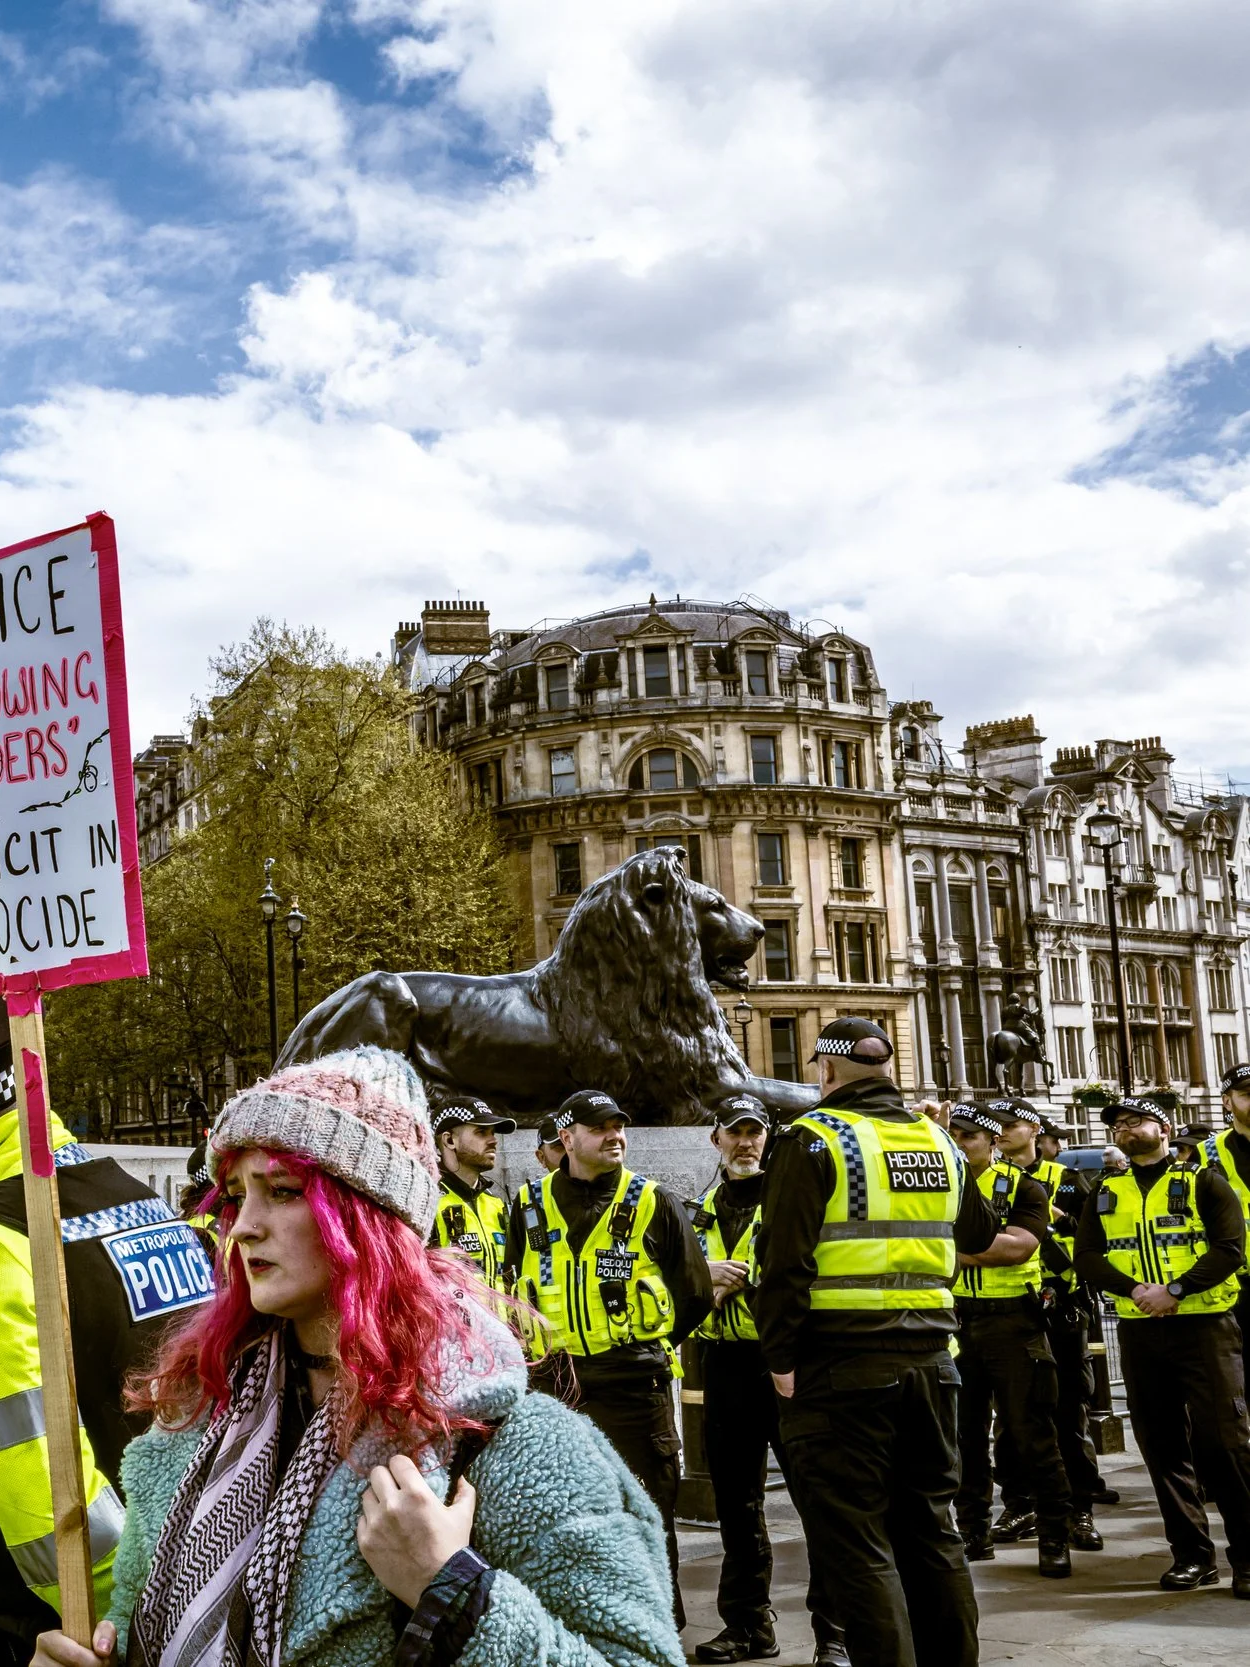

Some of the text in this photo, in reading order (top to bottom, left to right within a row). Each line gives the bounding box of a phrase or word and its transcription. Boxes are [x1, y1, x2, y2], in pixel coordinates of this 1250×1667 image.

[89, 819, 119, 869] IN
[886, 1152, 944, 1168] HEDDLU
[892, 1171, 948, 1187] POLICE
[113, 1229, 196, 1258] METROPOLITA
[125, 1248, 215, 1309] POLICE
[597, 1267, 631, 1279] POLICE
